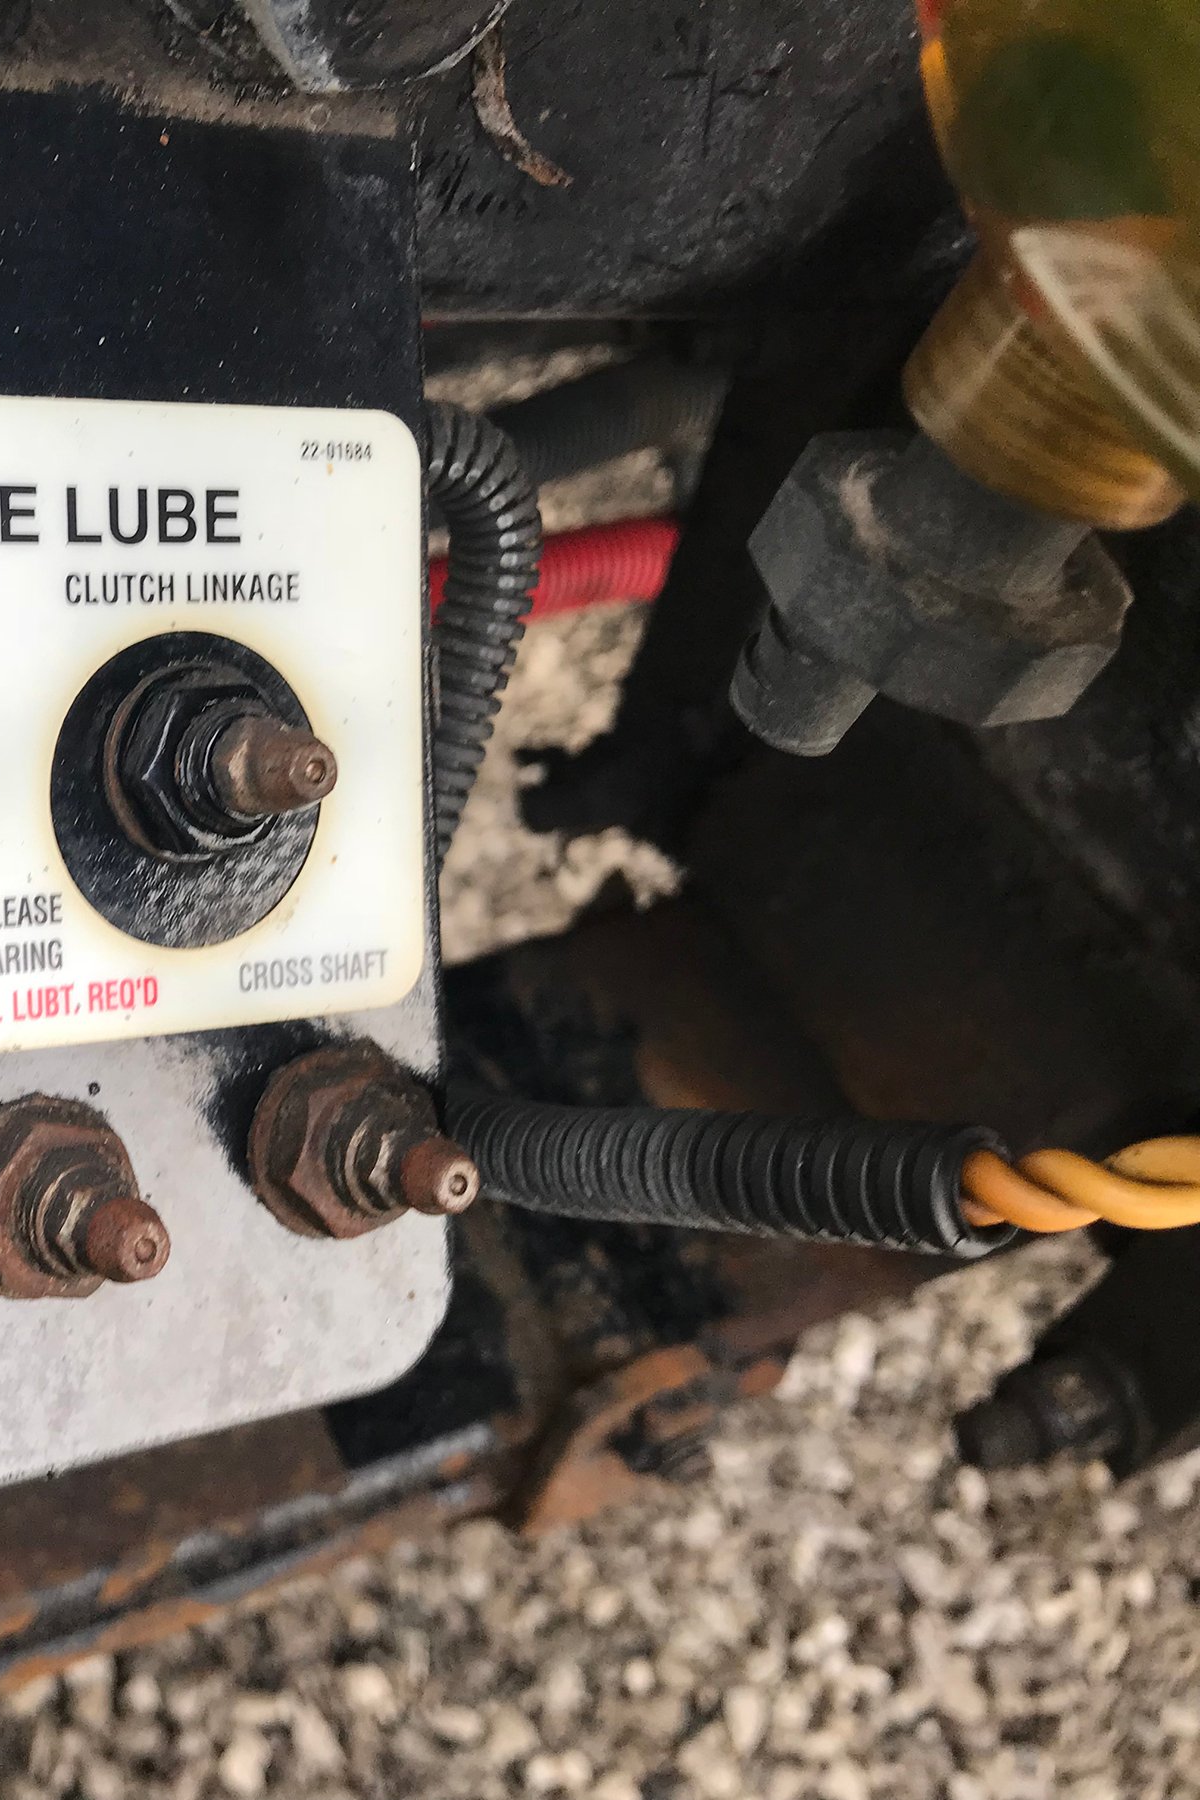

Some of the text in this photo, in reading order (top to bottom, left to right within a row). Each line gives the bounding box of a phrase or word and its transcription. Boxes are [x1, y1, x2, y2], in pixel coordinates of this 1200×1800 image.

[66, 486, 242, 545] LUBE
[65, 572, 299, 605] CLUTCH LINKAGE
[238, 950, 388, 993] CROSS SHAFT
[88, 975, 159, 1014] REQ'D
